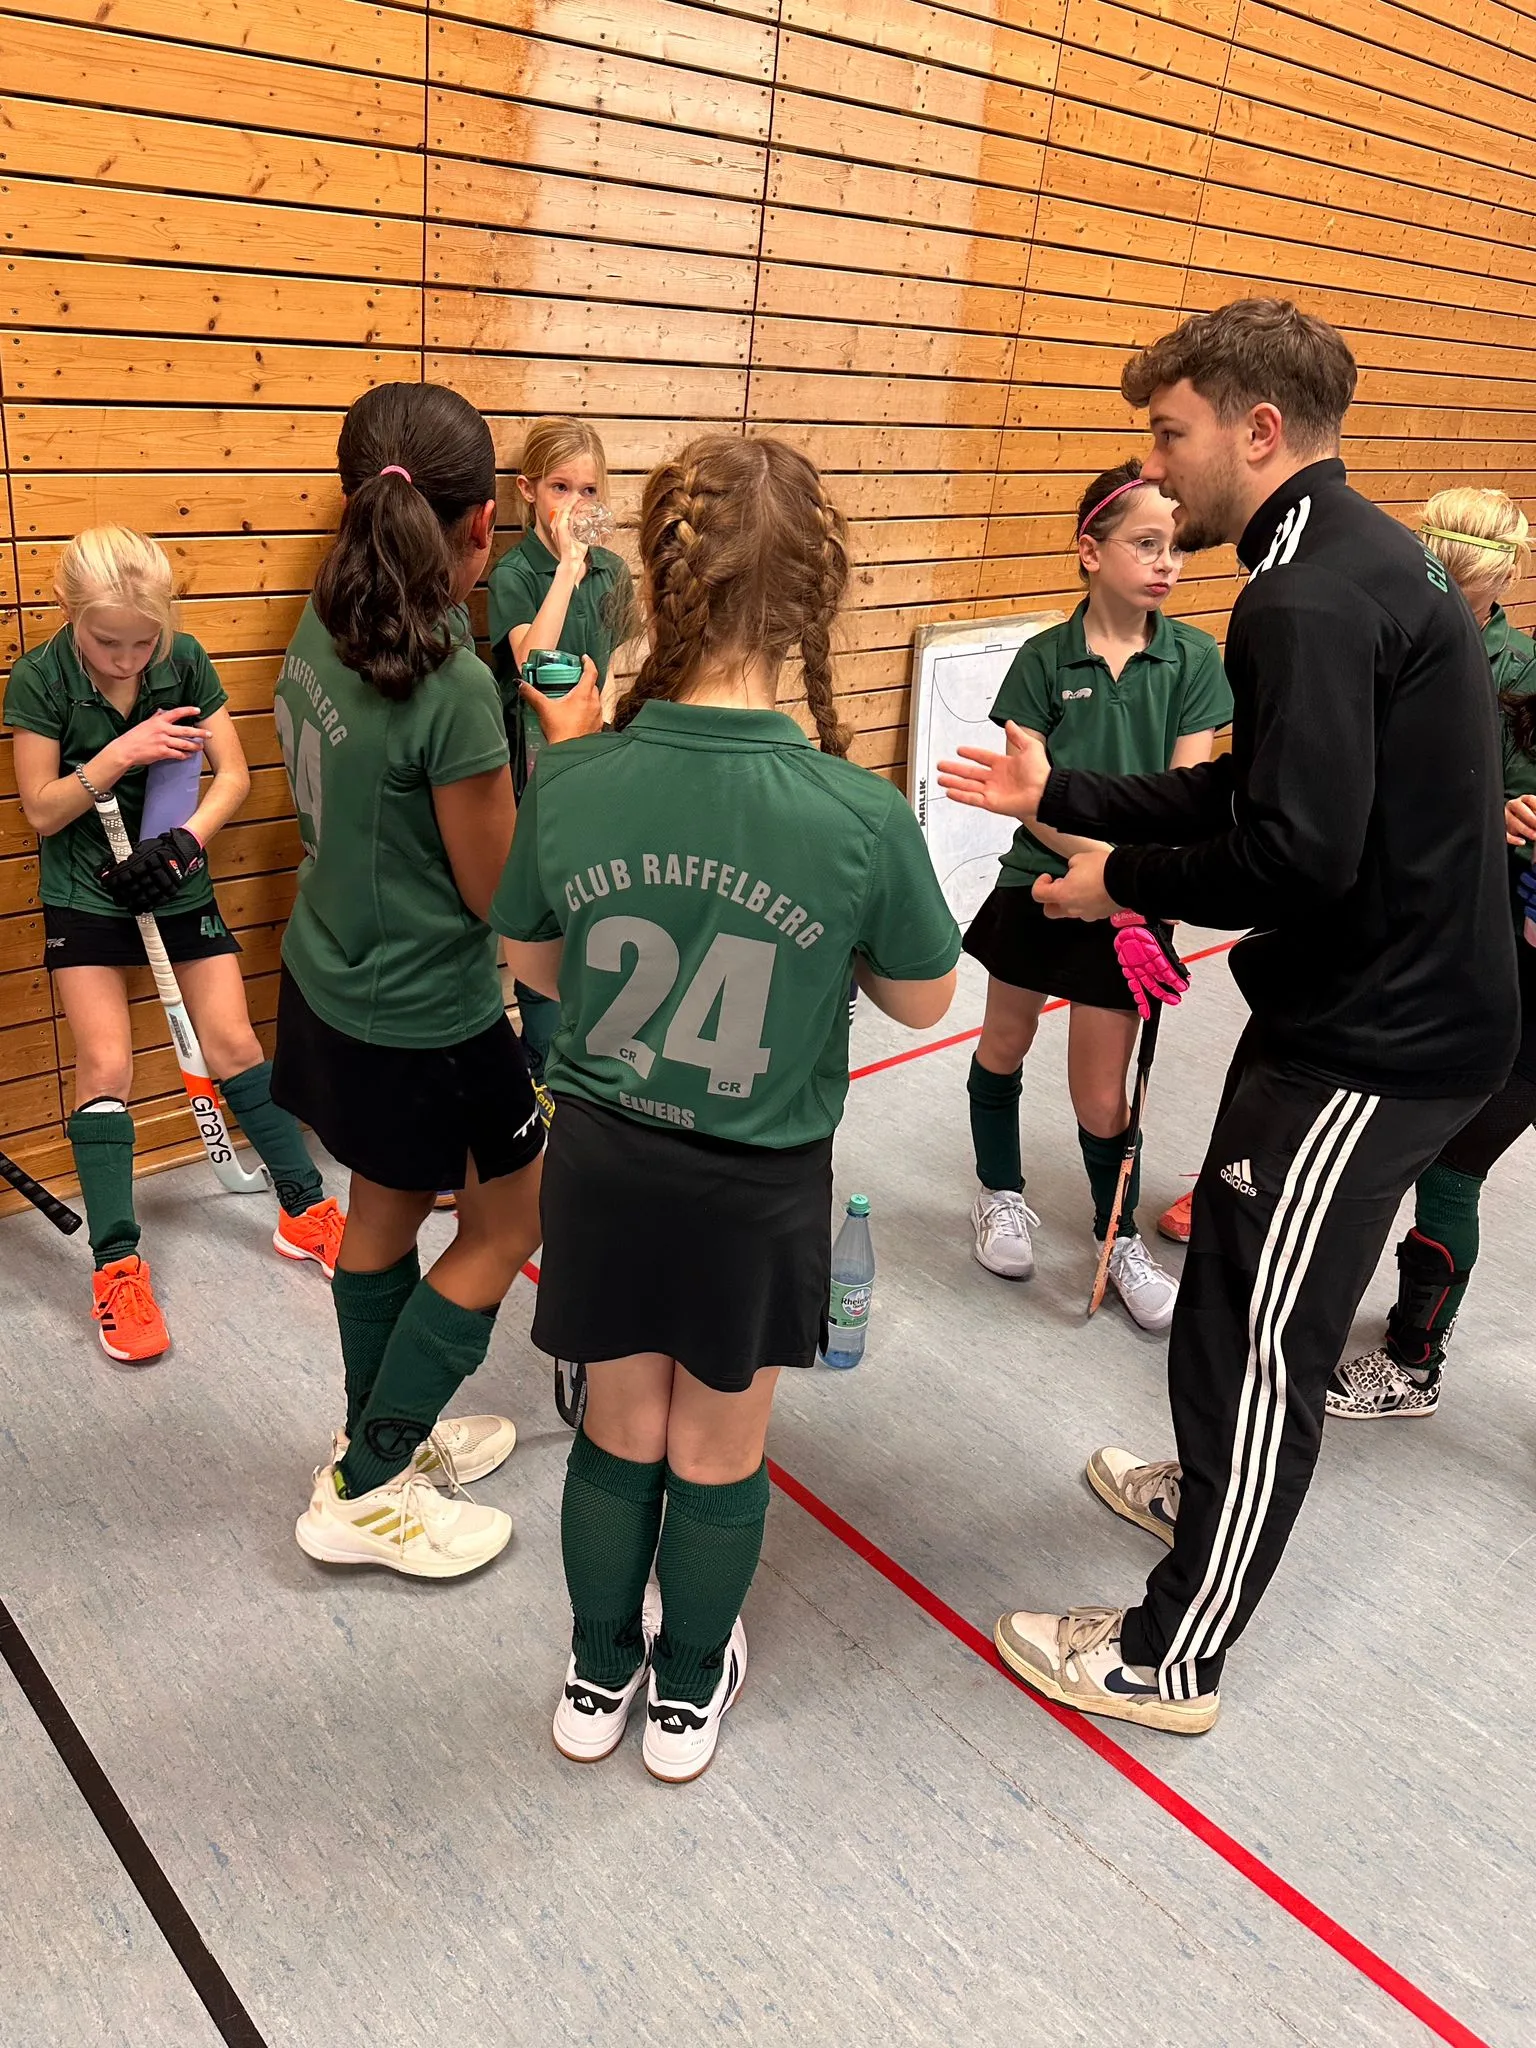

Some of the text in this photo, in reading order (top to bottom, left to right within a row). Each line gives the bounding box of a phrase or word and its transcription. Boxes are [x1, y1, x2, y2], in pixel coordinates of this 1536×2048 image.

[287, 655, 349, 747] RAFFELBERG
[564, 853, 825, 950] CLUB RAFFELBERG
[200, 915, 227, 939] 44
[585, 915, 777, 1098] 24
[619, 1047, 637, 1064] CR
[717, 1080, 741, 1094] CR
[619, 1091, 696, 1129] ELVERS
[191, 1095, 232, 1164] Grays
[1220, 1168, 1258, 1197] adidas
